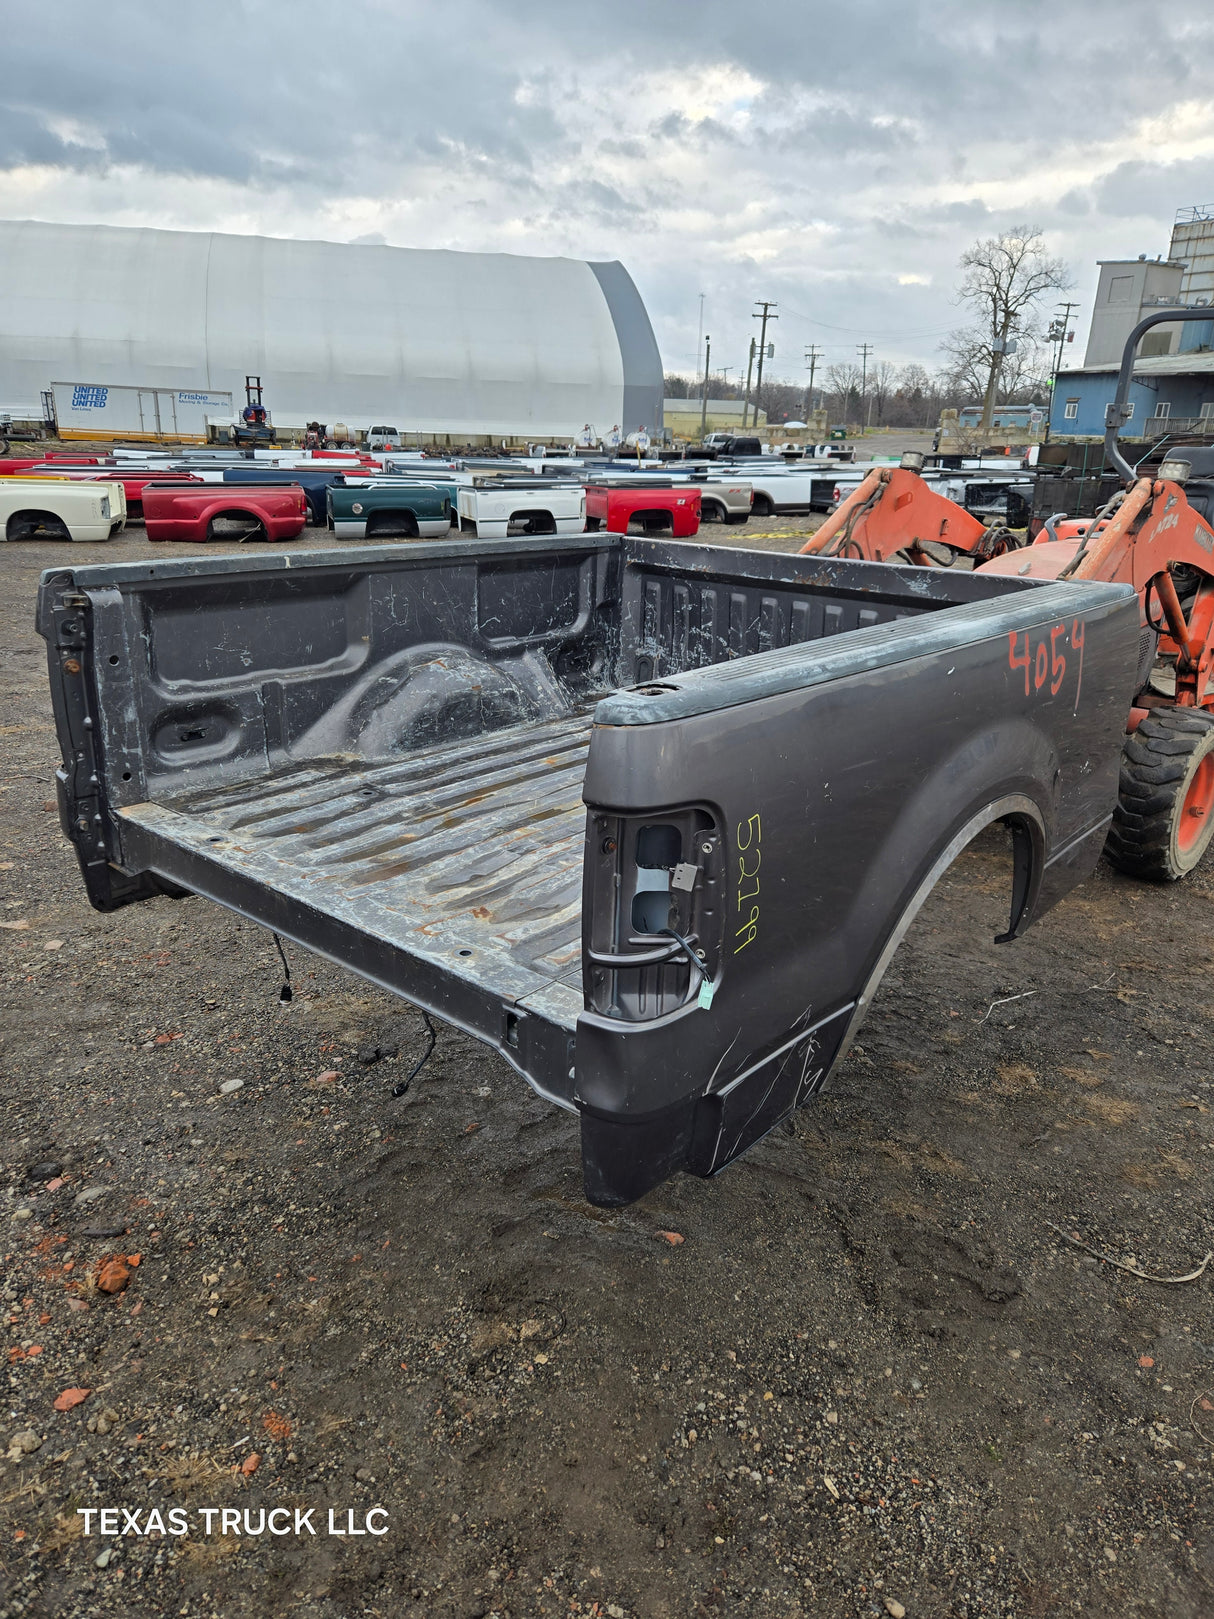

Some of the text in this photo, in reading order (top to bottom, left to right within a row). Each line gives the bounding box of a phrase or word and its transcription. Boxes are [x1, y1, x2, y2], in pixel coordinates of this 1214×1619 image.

[74, 386, 108, 394] UNITED
[73, 393, 107, 401] UNITED
[72, 400, 106, 408] UNITED
[733, 813, 761, 954] 52199
